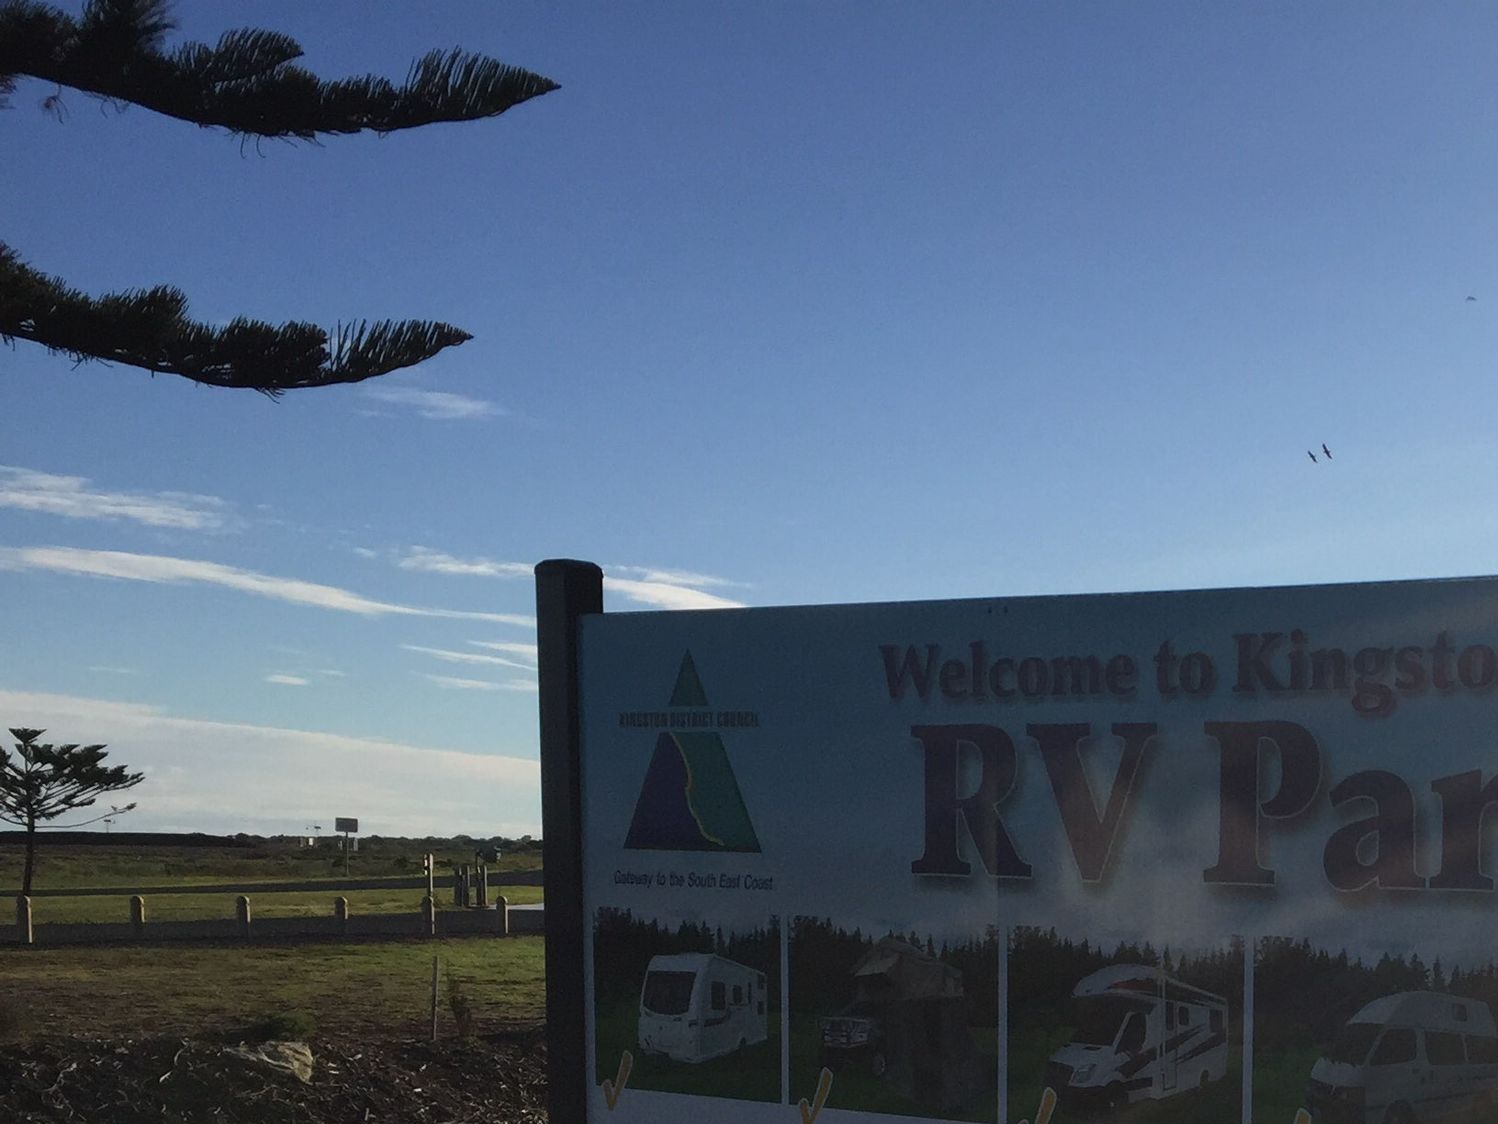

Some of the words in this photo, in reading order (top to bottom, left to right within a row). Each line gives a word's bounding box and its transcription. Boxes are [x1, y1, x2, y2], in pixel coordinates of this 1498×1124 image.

[879, 640, 1140, 699] Welcome
[1155, 640, 1214, 694] to
[910, 722, 1158, 884] RV
[614, 870, 653, 889] Gateway
[656, 872, 666, 886] to
[669, 873, 685, 887] the
[687, 872, 717, 888] South
[719, 874, 741, 889] East
[743, 875, 774, 890] Coast
